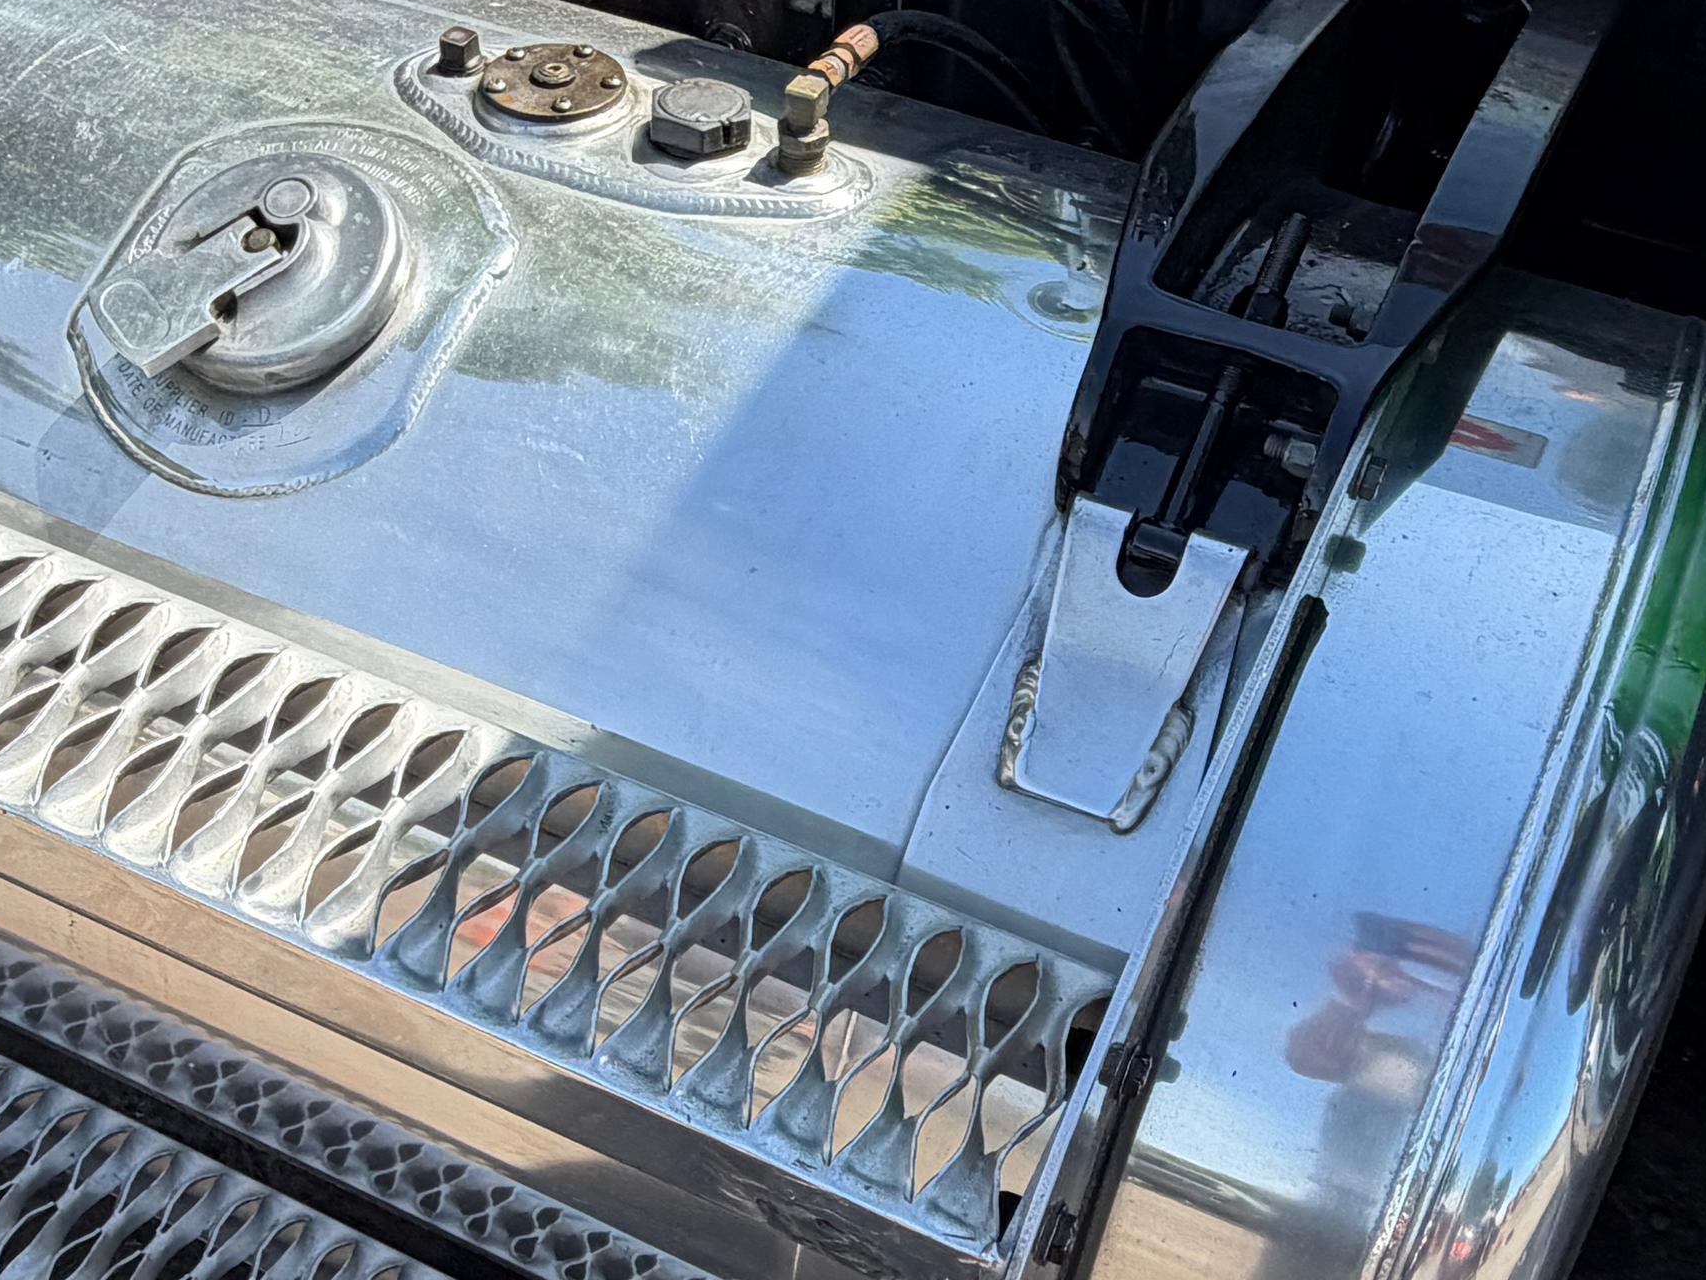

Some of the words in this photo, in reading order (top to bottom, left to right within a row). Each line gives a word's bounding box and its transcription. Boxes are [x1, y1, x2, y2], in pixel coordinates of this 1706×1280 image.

[116, 361, 145, 398] DATE
[143, 396, 164, 414] OF
[155, 372, 209, 418] UPPLIER
[220, 409, 235, 426] ID
